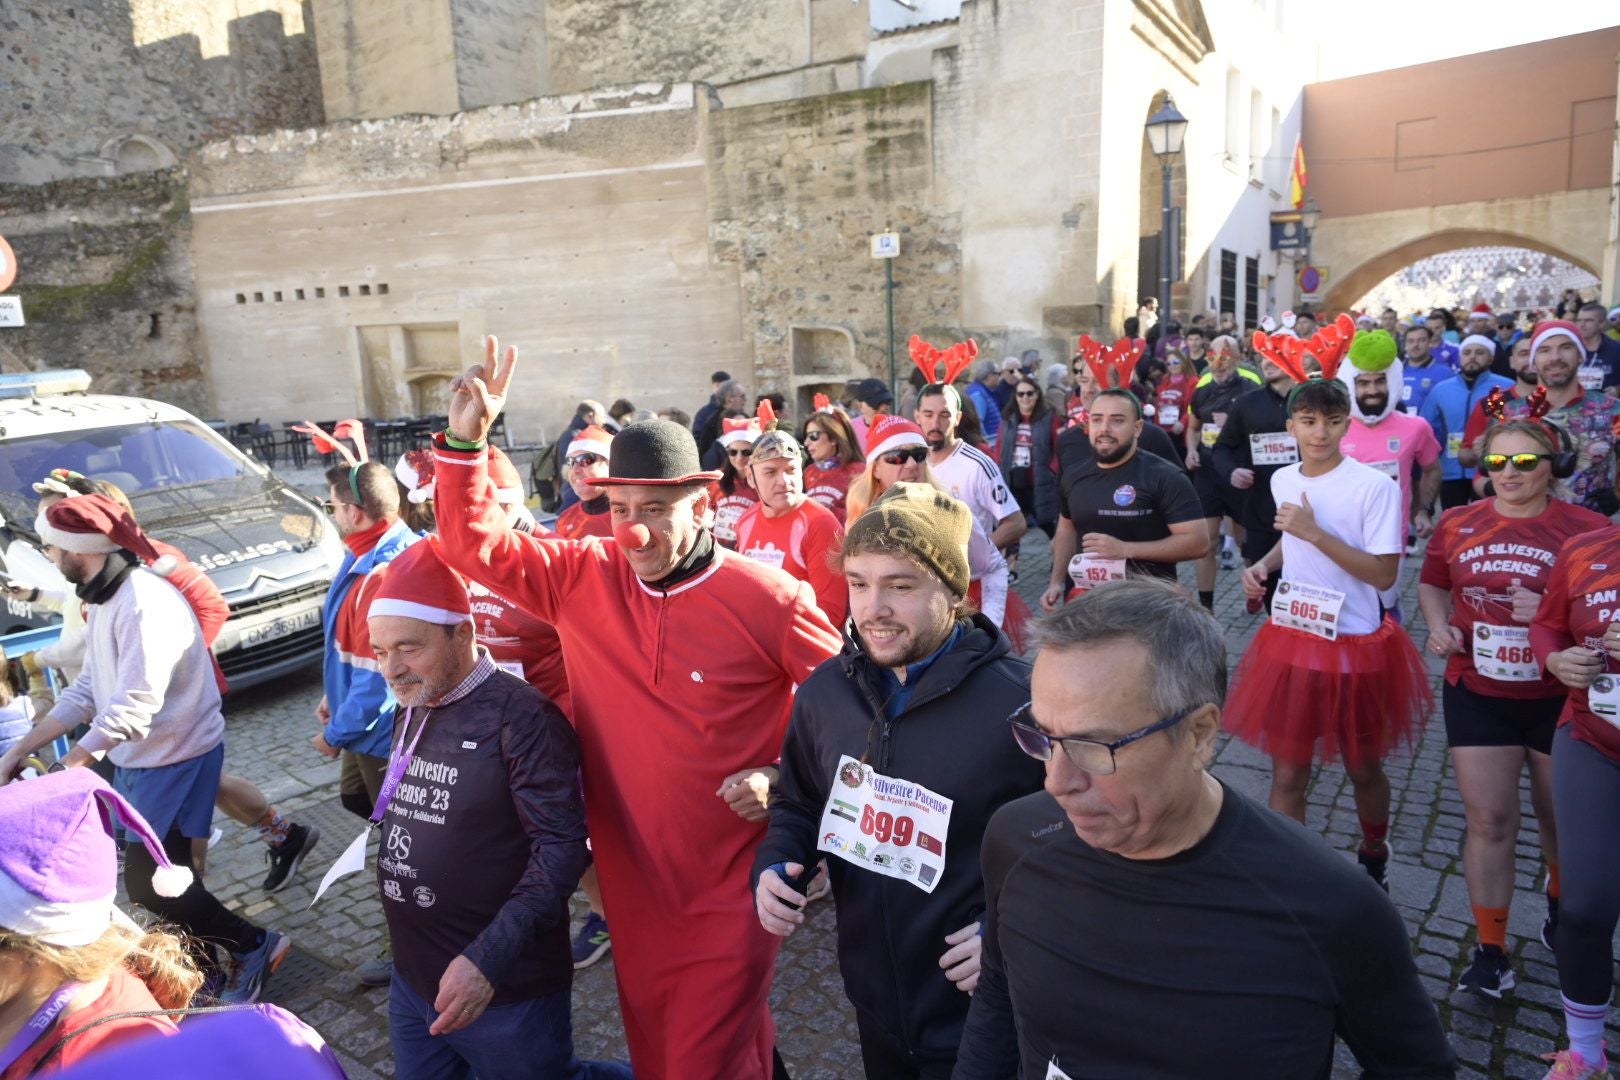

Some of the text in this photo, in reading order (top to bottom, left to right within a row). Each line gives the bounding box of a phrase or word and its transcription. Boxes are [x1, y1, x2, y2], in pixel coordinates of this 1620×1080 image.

[1459, 545, 1484, 563] SAN
[1085, 567, 1108, 582] 152
[1471, 560, 1541, 577] PACENSE
[1585, 589, 1617, 607] SAN
[1290, 600, 1319, 620] 605
[248, 612, 317, 643] CNP 3691 AL
[1495, 646, 1534, 664] 468
[859, 803, 915, 847] 699
